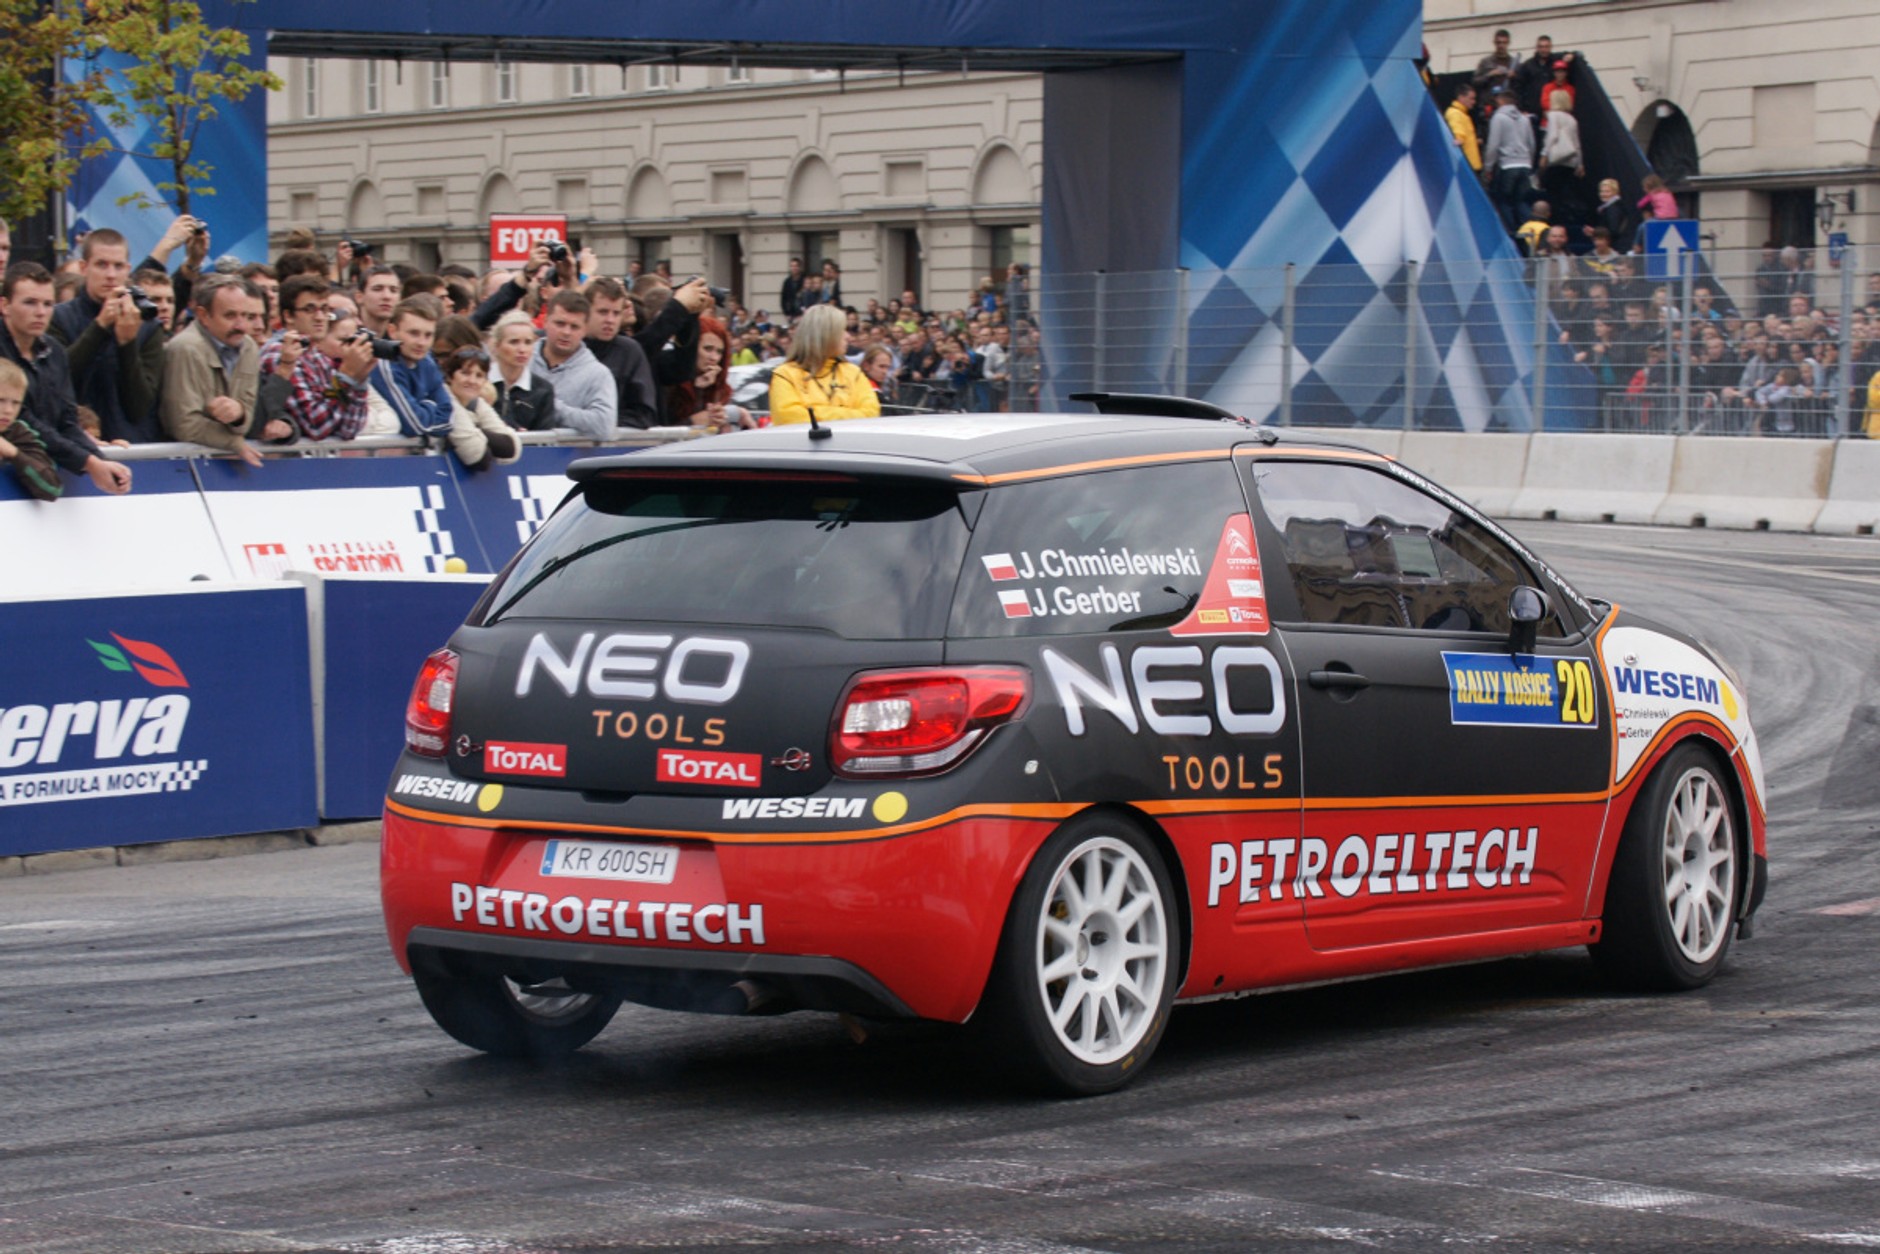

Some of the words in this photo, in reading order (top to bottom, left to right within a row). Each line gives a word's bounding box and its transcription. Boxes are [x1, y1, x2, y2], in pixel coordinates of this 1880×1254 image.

[498, 228, 560, 253] FOTO
[1020, 547, 1202, 579] J.Chmielewski
[1032, 585, 1141, 617] J.Gerber
[515, 632, 751, 703] NEO
[1042, 645, 1286, 736] NEO
[1455, 669, 1501, 704] RALLY
[1502, 666, 1553, 706] KOŠICE
[1558, 660, 1594, 723] 20
[1614, 666, 1720, 705] WESEM
[0, 694, 190, 768] erva
[592, 709, 727, 746] TOOLS
[1627, 727, 1653, 738] Gerber
[488, 746, 562, 771] TOTAL
[662, 754, 757, 782] TOTAL
[1162, 755, 1283, 790] TOOLS
[13, 776, 101, 799] FORMUŁA
[106, 771, 161, 791] MOCY
[395, 775, 478, 803] WESEM
[721, 798, 867, 819] WESEM
[561, 846, 591, 872] KR
[597, 848, 668, 876] 600SH
[1208, 827, 1539, 908] PETROELTECH
[451, 882, 766, 945] PETROELTECH
